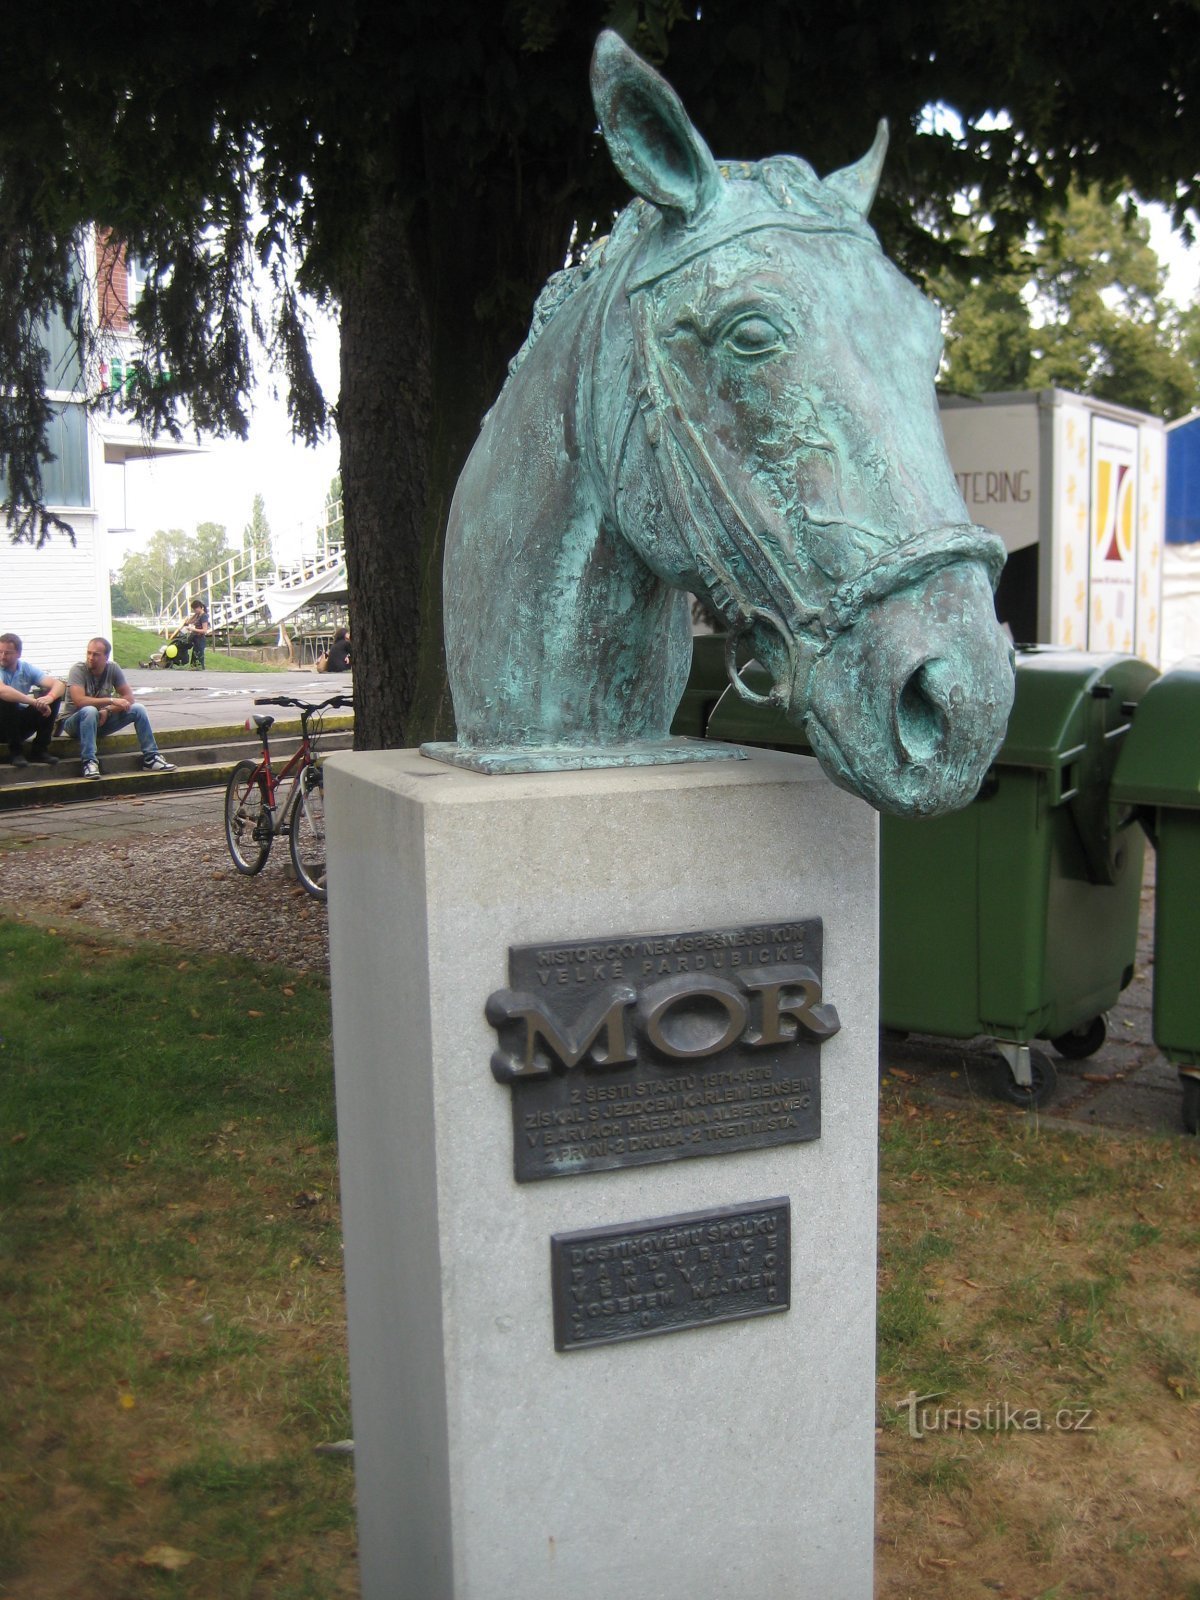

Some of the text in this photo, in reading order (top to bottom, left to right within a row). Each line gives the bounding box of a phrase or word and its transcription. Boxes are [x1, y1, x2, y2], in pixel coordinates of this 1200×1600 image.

[536, 943, 804, 986] VELKÉ PARDUBICKÉ
[485, 965, 841, 1084] MOR
[587, 1106, 600, 1121] S
[603, 1095, 678, 1120] JEZDCEM
[682, 1086, 747, 1110] KARLEM
[706, 1216, 777, 1243] SPOLKU
[571, 1234, 777, 1285] PARDUBICE
[571, 1289, 676, 1320] JOSEFEM
